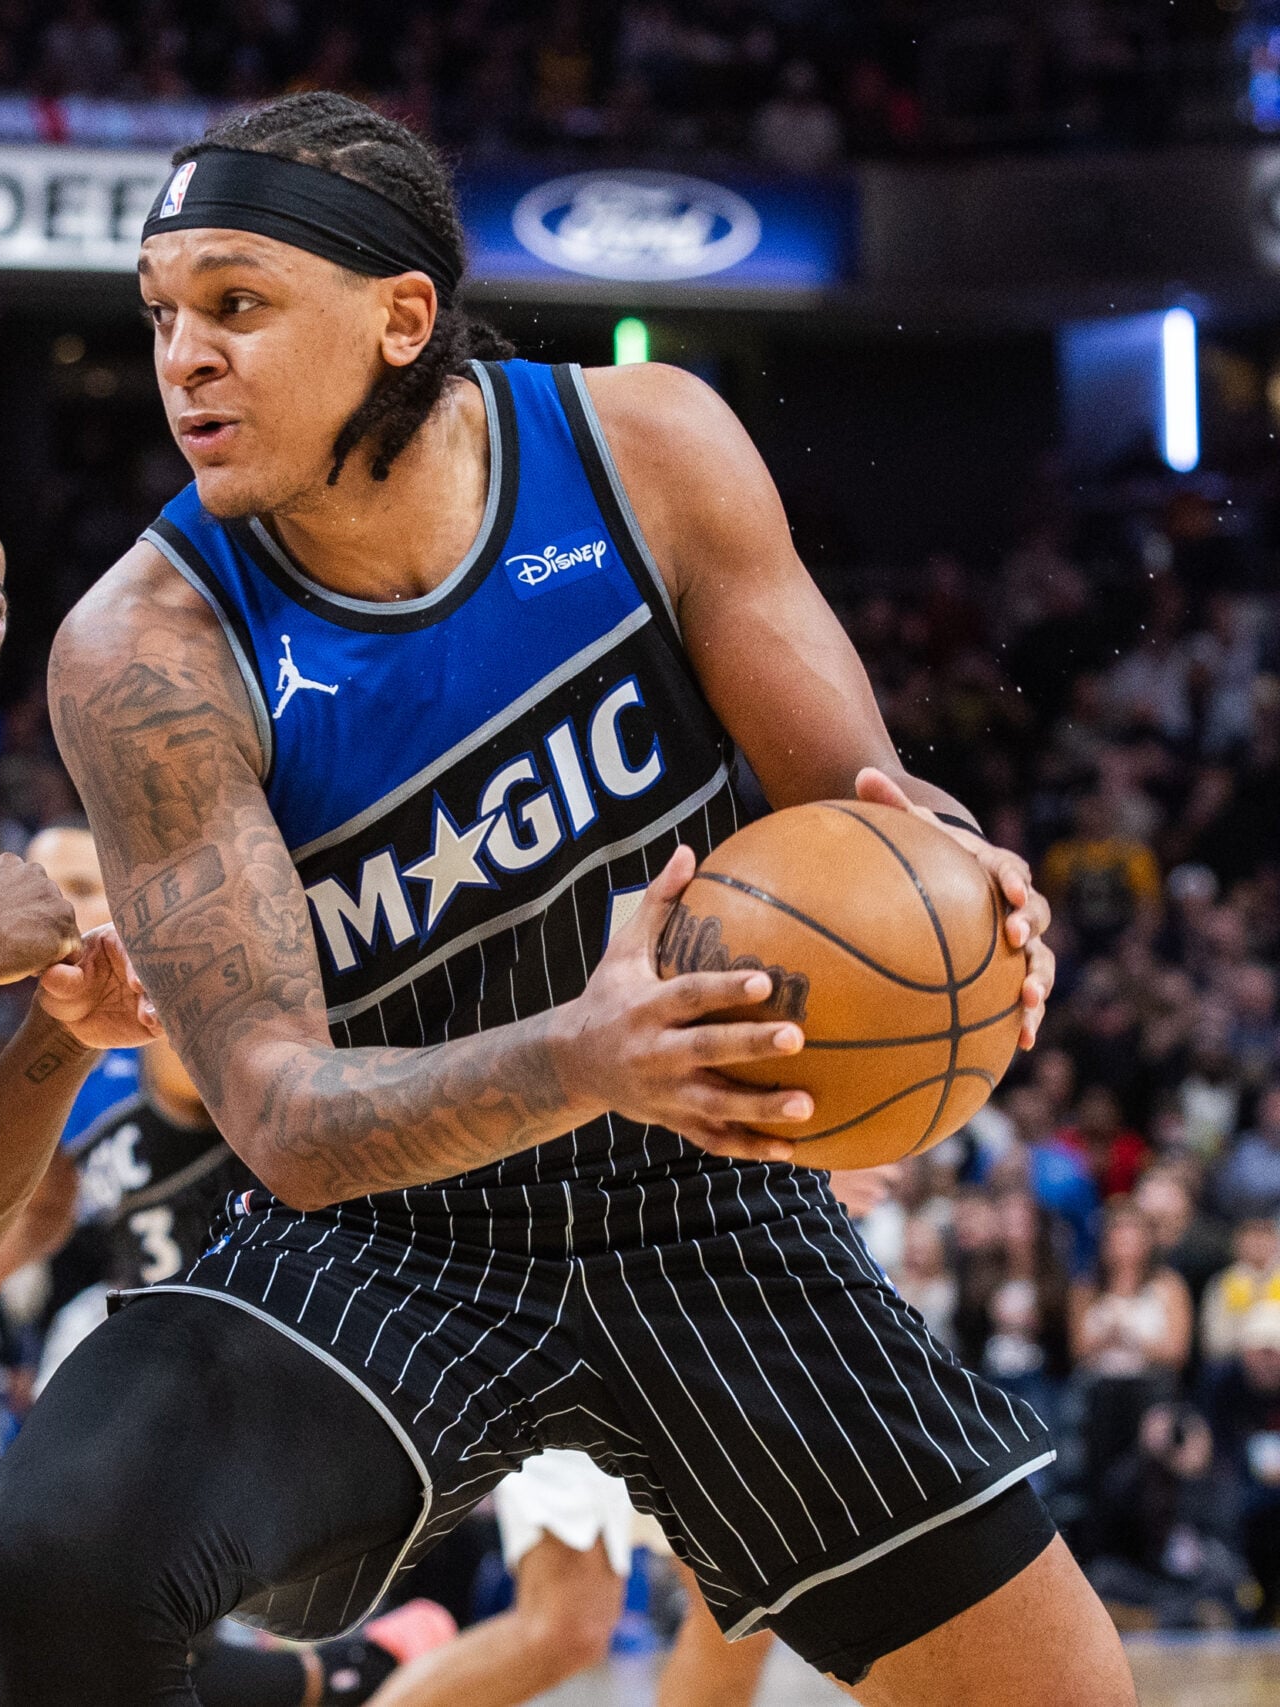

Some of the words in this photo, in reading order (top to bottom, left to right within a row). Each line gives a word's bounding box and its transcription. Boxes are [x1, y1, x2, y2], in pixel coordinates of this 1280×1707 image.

[505, 540, 607, 586] Disney
[305, 674, 667, 976] MAGIC
[128, 1205, 183, 1286] 3
